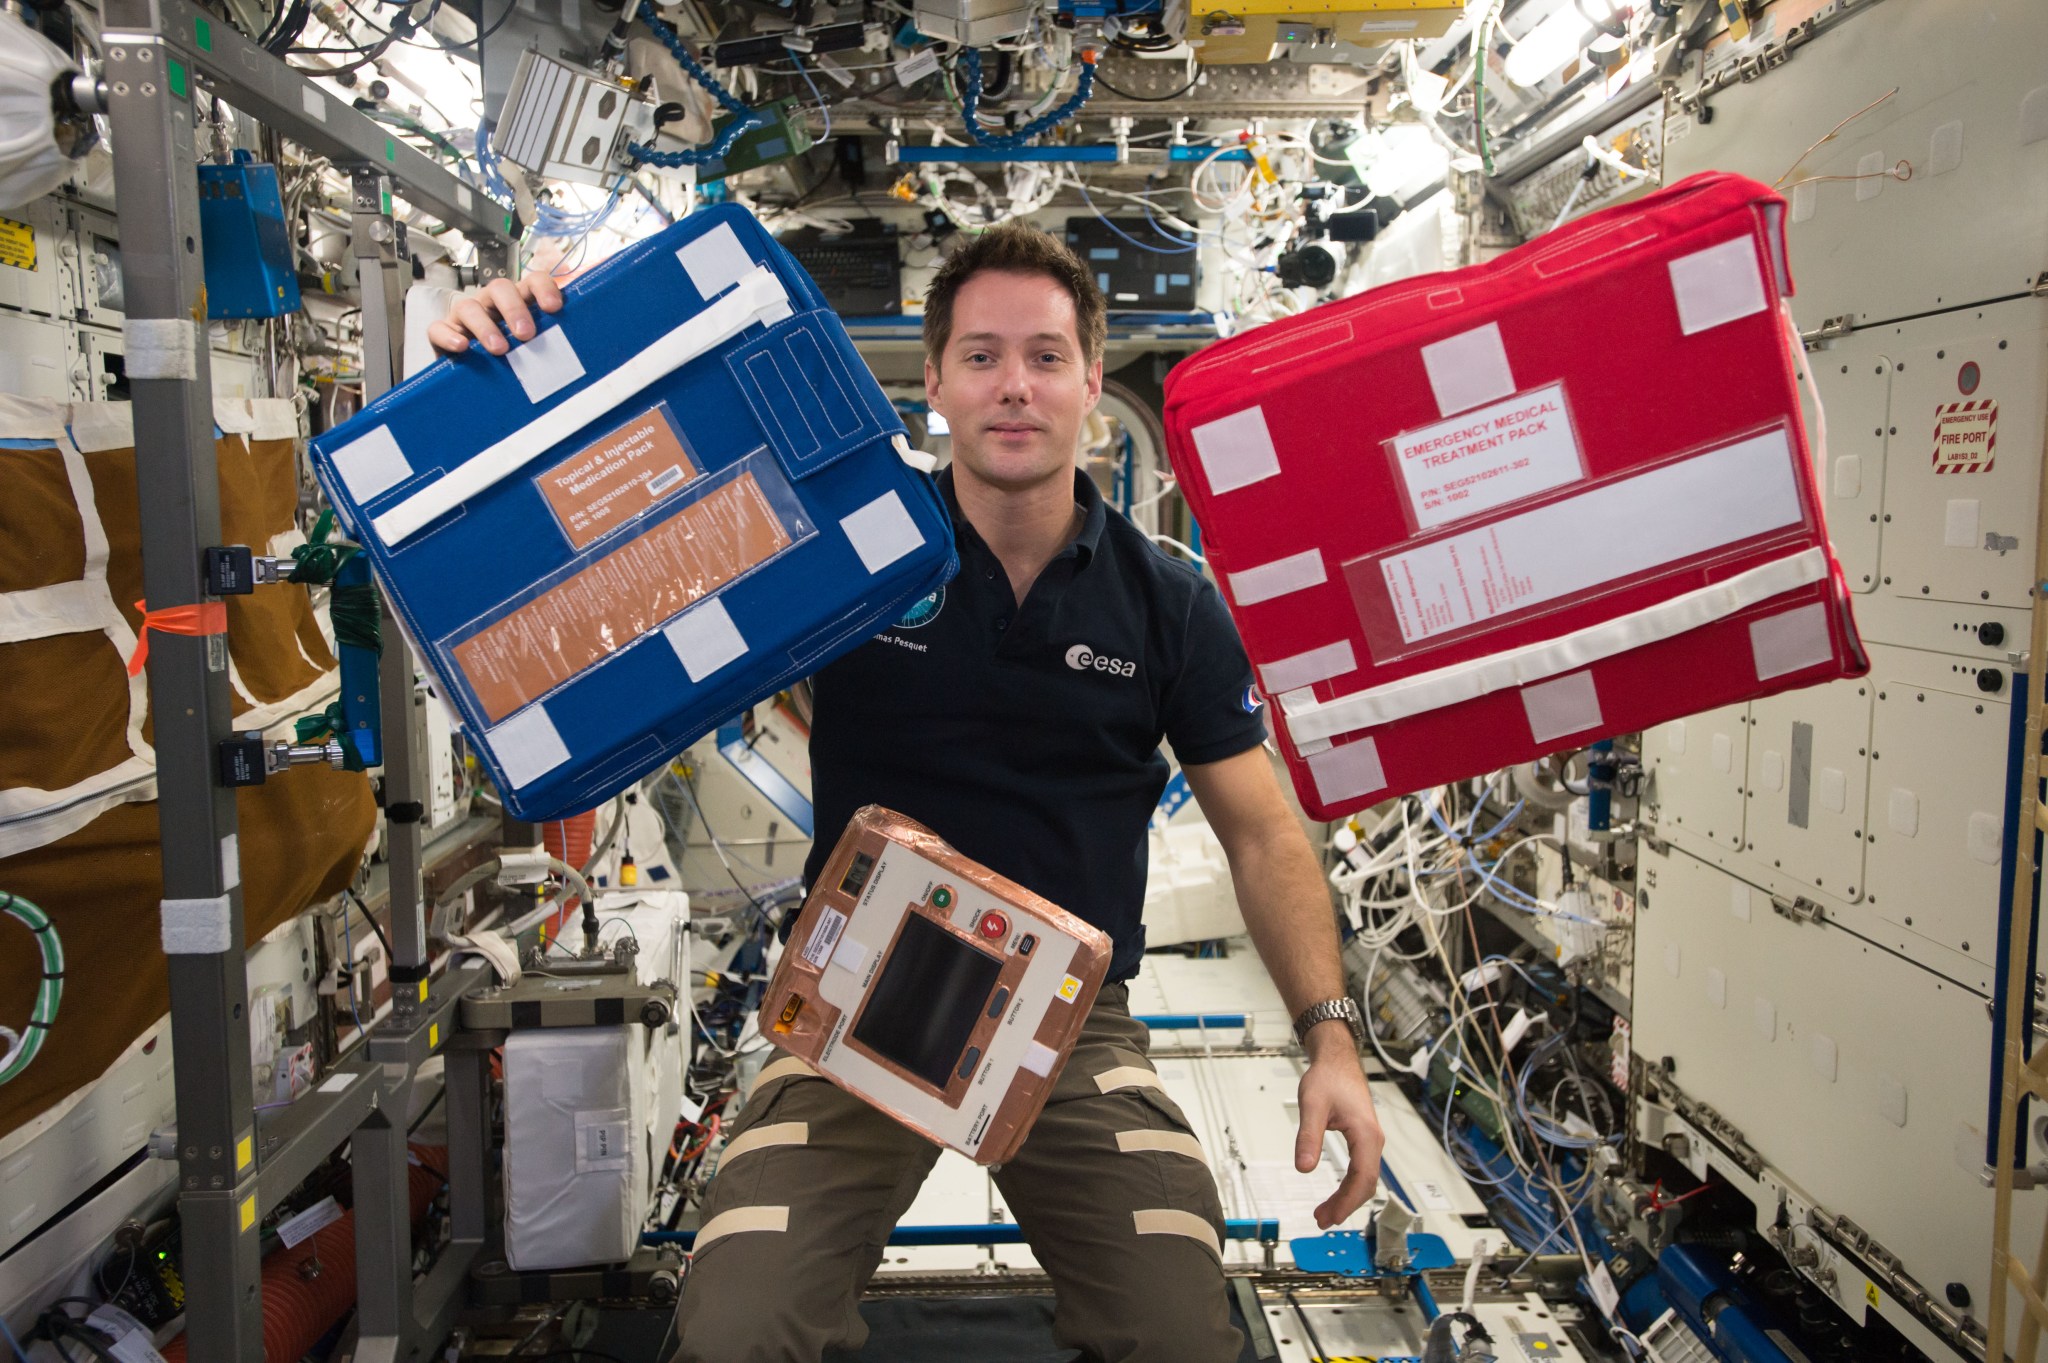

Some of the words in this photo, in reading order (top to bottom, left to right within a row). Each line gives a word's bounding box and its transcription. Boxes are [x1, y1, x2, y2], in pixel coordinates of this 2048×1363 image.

[1942, 414, 1976, 424] EMERGENCY
[1977, 413, 1989, 421] USE
[1403, 422, 1491, 459] EMERGENCY
[1494, 401, 1558, 430] MEDICAL
[1941, 434, 1961, 445] FIRE
[1962, 431, 1987, 443] PORT
[1422, 434, 1505, 470] TREATMENT
[1508, 420, 1548, 442] PACK
[555, 462, 593, 488] Topical
[594, 455, 604, 466] &
[604, 425, 655, 460] Injectable
[569, 457, 627, 496] Medication
[626, 440, 655, 461] Pack
[1420, 487, 1441, 500] P/N:
[1424, 498, 1444, 510] S/N:
[568, 509, 587, 523] P/N:
[574, 519, 592, 532] S/N:
[873, 634, 893, 643] mas
[894, 636, 928, 652] Pesquet
[862, 883, 877, 906] STATUS
[873, 862, 887, 886] DISPLAY
[921, 881, 934, 902] ON/OFF
[969, 908, 982, 929] SHOCK
[1010, 933, 1021, 949] MENU
[862, 974, 872, 988] MAIN
[868, 951, 883, 976] DISPLAY
[1007, 1003, 1021, 1026] BUTTON
[823, 1030, 841, 1063] ELECTRODE
[839, 1014, 848, 1031] PORT
[978, 1061, 992, 1086] BUTTON
[965, 1119, 980, 1146] BATTERY
[978, 1104, 988, 1121] PORT
